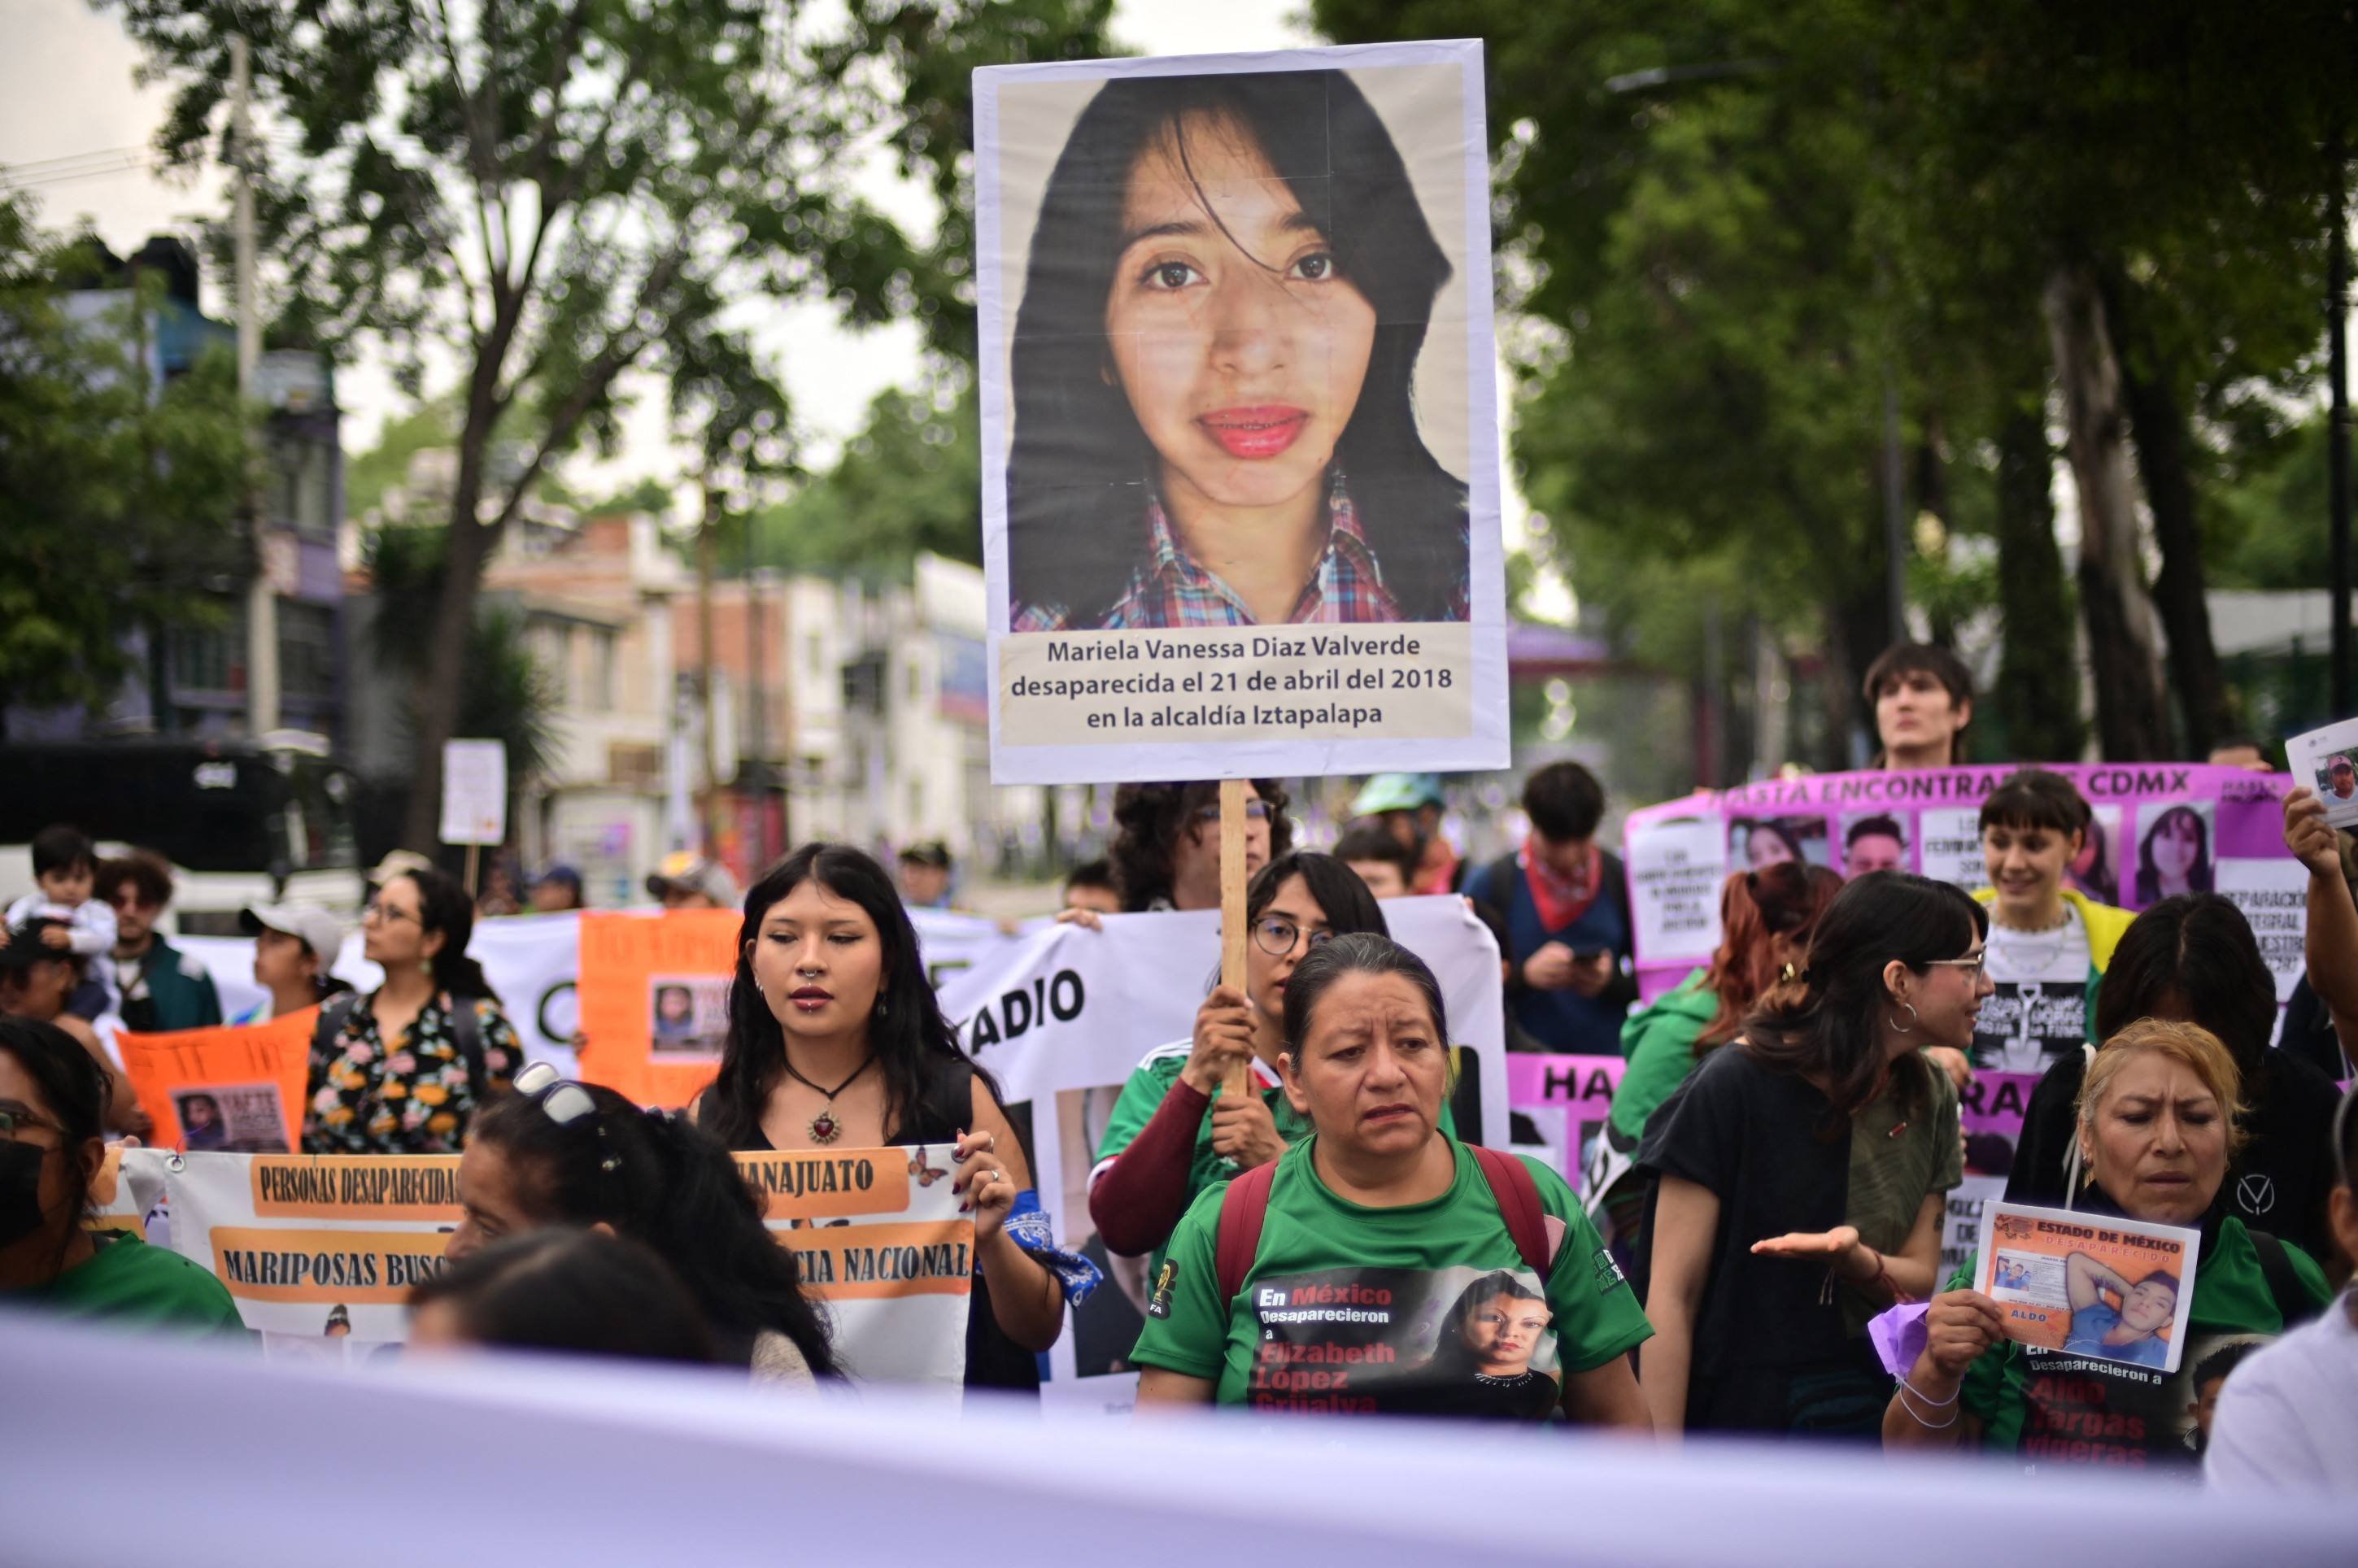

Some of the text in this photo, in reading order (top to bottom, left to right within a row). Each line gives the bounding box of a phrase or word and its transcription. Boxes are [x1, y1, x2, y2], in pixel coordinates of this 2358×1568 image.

[1048, 634, 1420, 661] Mariela Vanessa Diaz Valverde
[1011, 669, 1453, 699] desaparecida el 21 de abril del 2018
[1087, 703, 1383, 729] en la alcaldía Iztapalapa
[1821, 773, 1997, 804] ENCONTRA
[2088, 770, 2190, 795] CDMX
[1544, 1065, 1614, 1101] HA
[260, 1165, 337, 1203] PERSONAS
[738, 1158, 874, 1198] ANAJUATO
[2037, 1221, 2094, 1239] ESTADO
[2098, 1230, 2118, 1244] DE
[2123, 1235, 2181, 1253] MÉXICO
[2045, 1235, 2171, 1263] DESAPARECIDO
[223, 1249, 449, 1287] MARIPOSAS BUSC
[791, 1243, 969, 1283] CIA NACIONAL
[1259, 1283, 1393, 1306] En México
[1149, 1304, 1162, 1314] FA
[1260, 1308, 1389, 1324] Desaparecieron
[2011, 1309, 2046, 1322] ALDO
[1266, 1329, 1273, 1339] a
[1262, 1341, 1396, 1365] Elizabeth
[1256, 1365, 1349, 1392] López
[2030, 1359, 2162, 1385] Desaparecieron a
